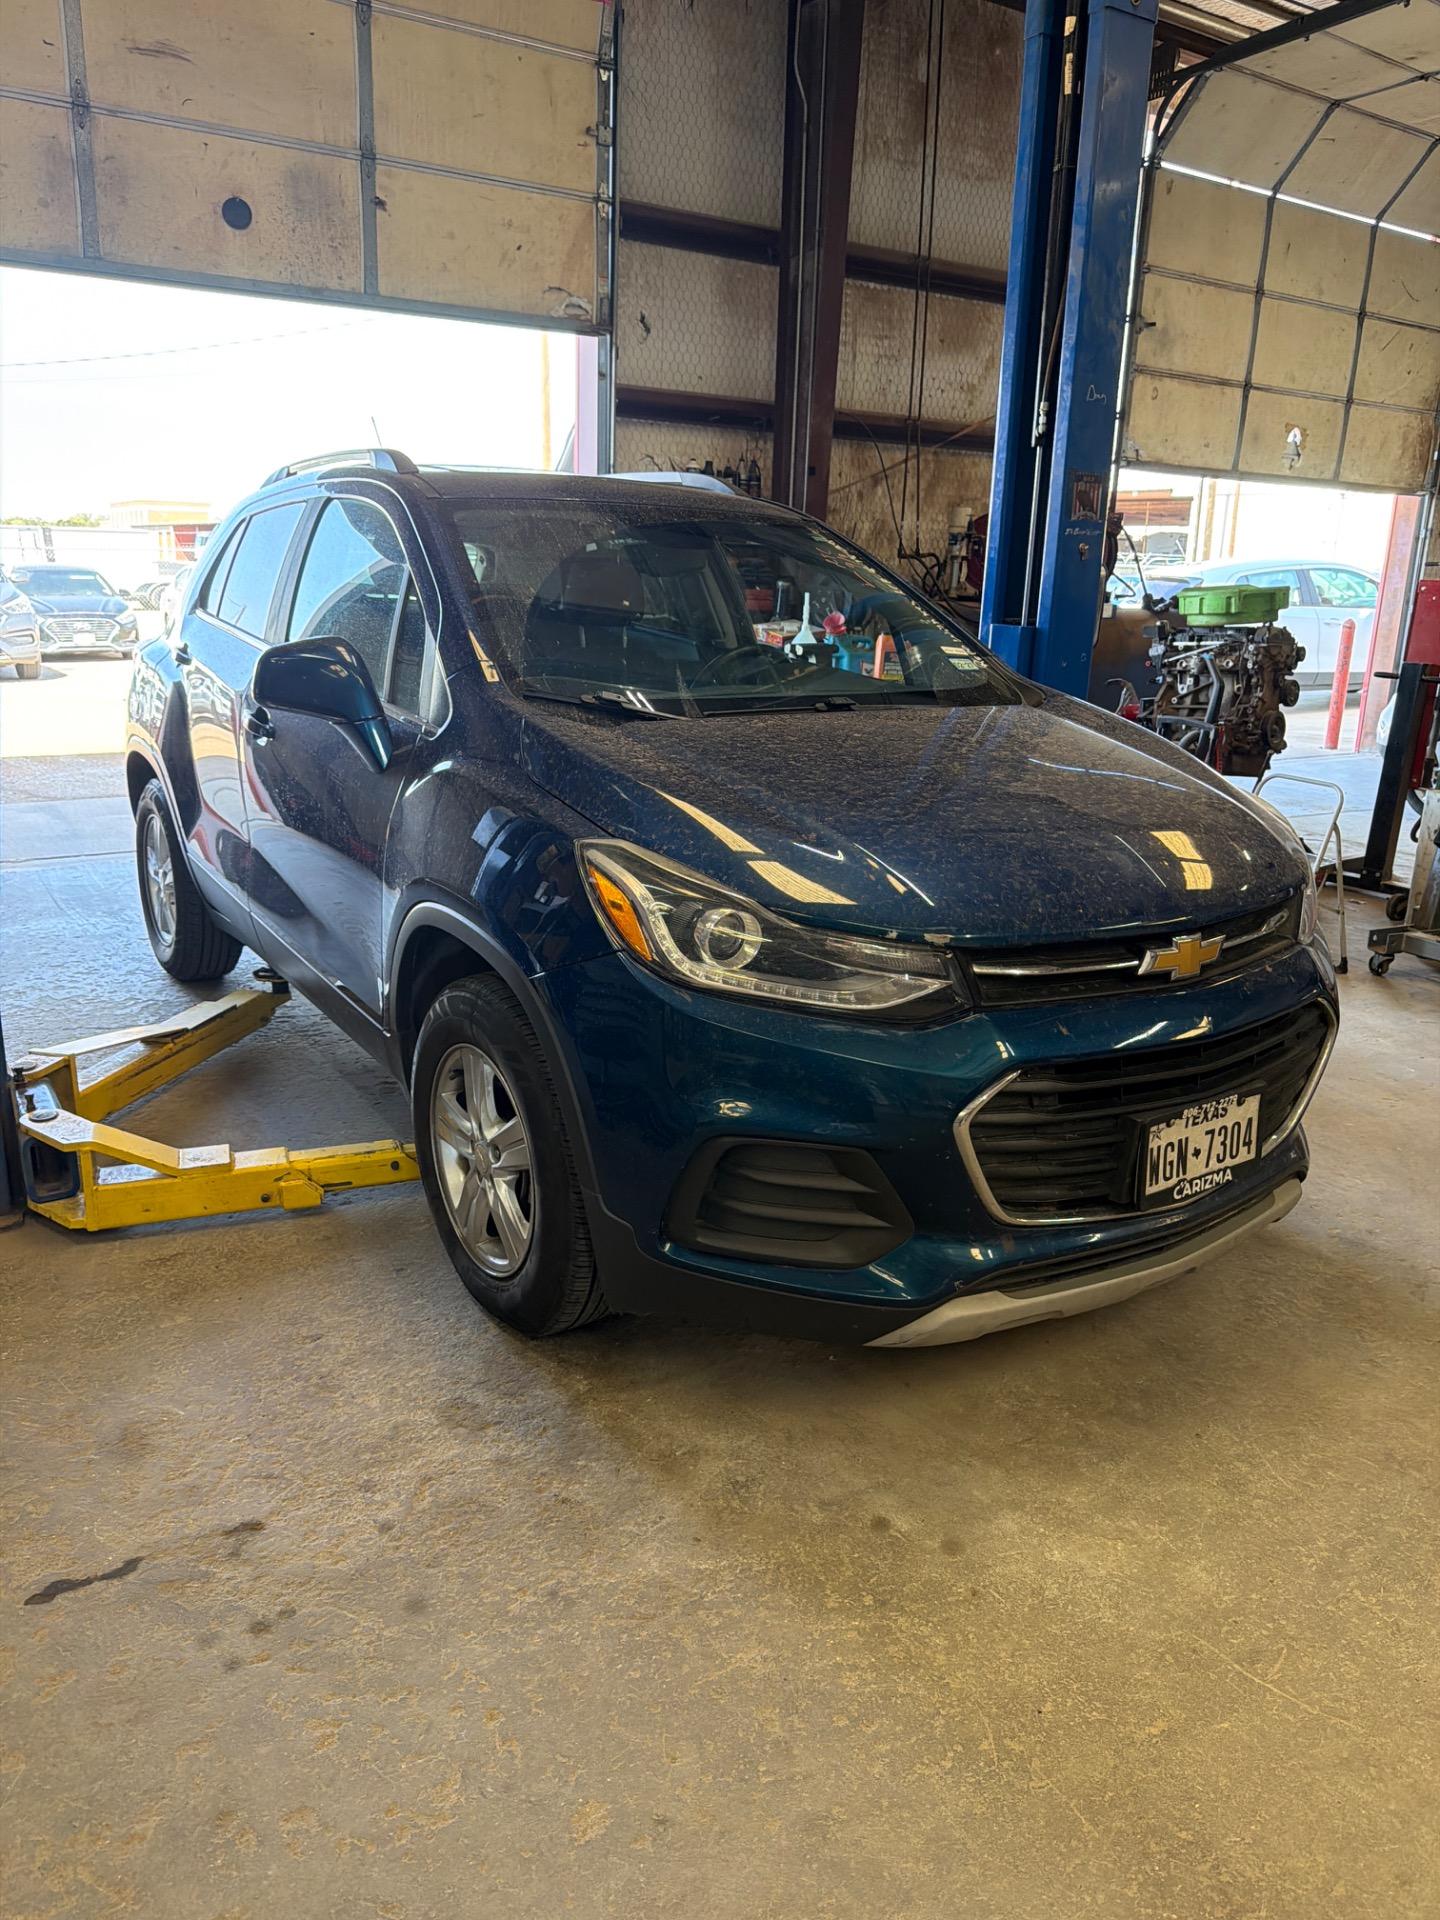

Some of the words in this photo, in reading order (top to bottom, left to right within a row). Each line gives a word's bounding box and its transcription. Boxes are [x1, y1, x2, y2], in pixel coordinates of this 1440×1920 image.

[1185, 1106, 1228, 1128] TEXAS
[1149, 1136, 1189, 1187] WGN
[1205, 1117, 1253, 1169] 7304
[1173, 1168, 1233, 1199] CARIZMA
